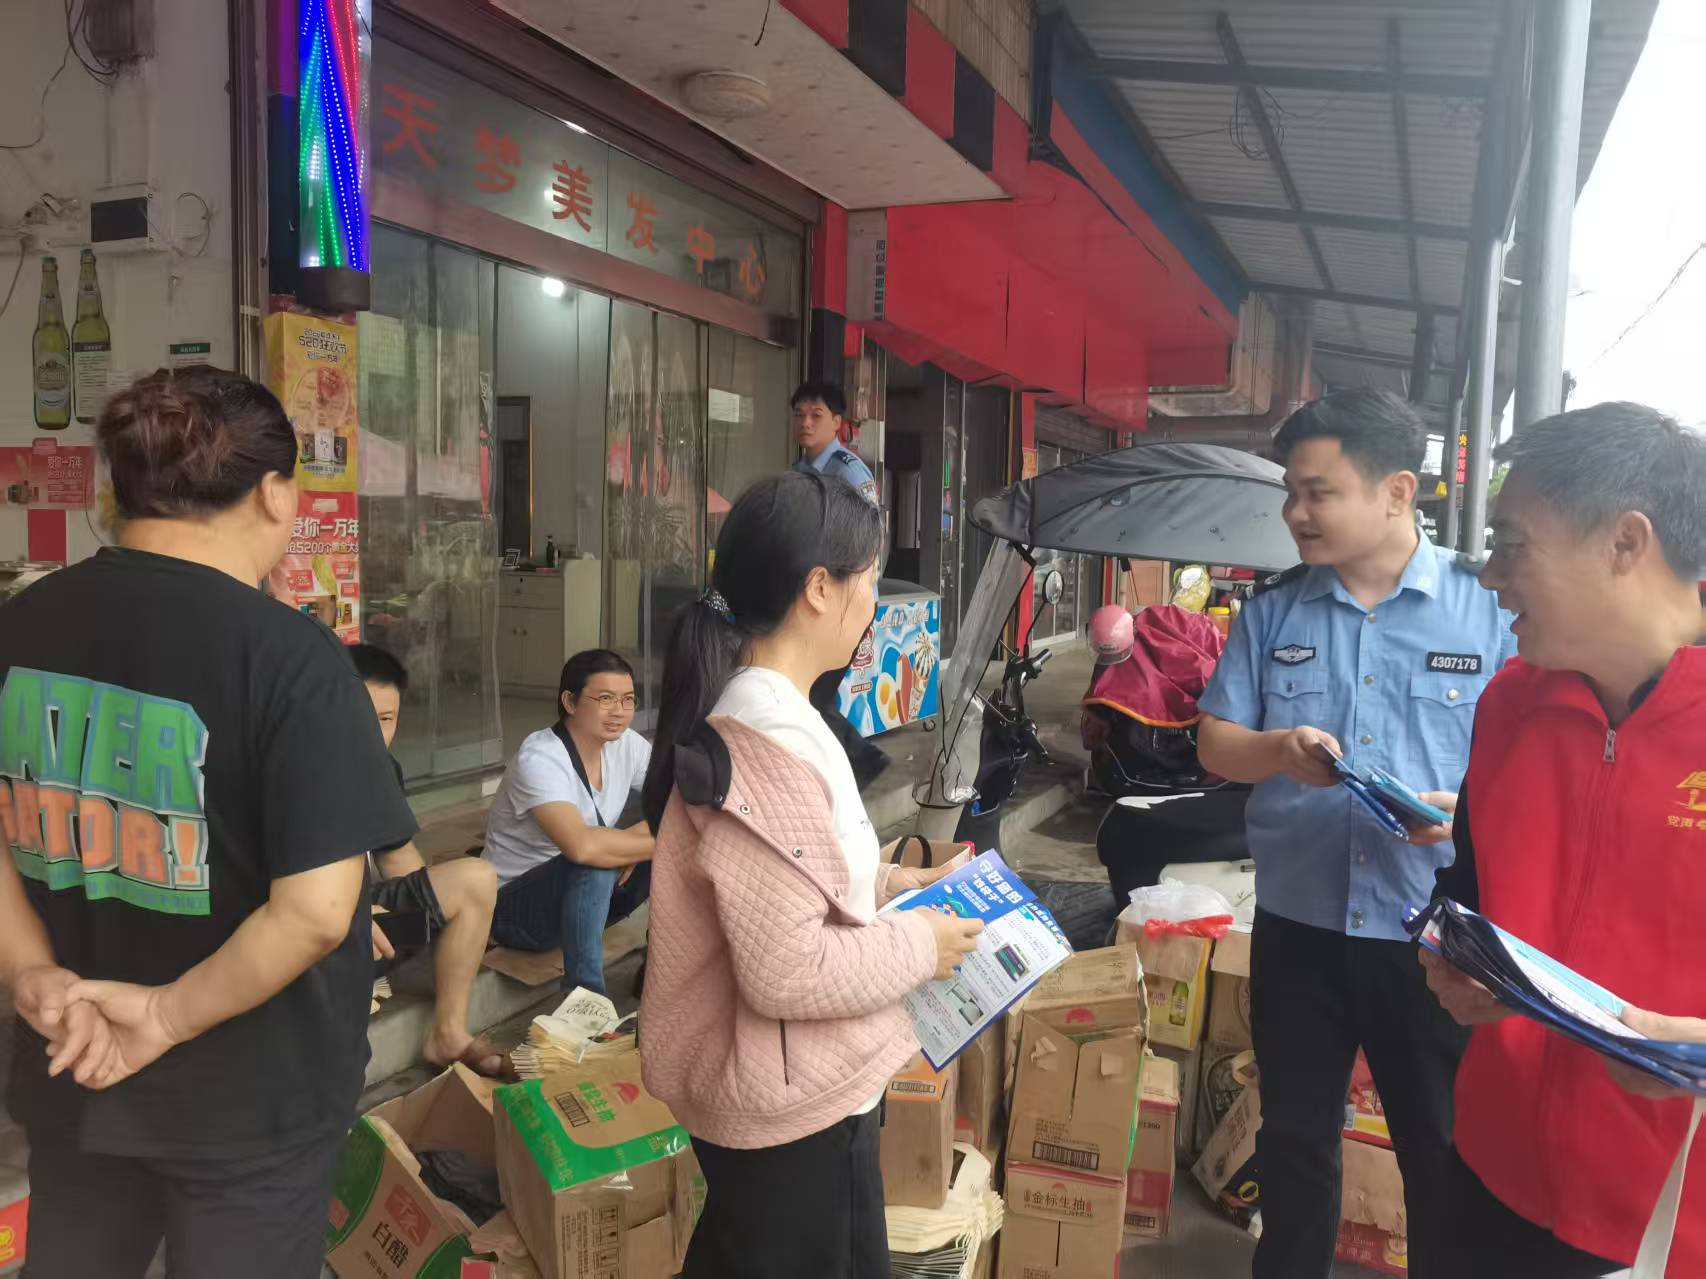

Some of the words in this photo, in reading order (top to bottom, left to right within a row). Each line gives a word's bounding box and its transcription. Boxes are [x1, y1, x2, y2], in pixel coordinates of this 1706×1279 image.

[381, 83, 767, 296] 天梦美发中心
[1431, 655, 1478, 670] 4307178
[1032, 1190, 1086, 1212] 金标生抽
[371, 1221, 410, 1269] 白醋
